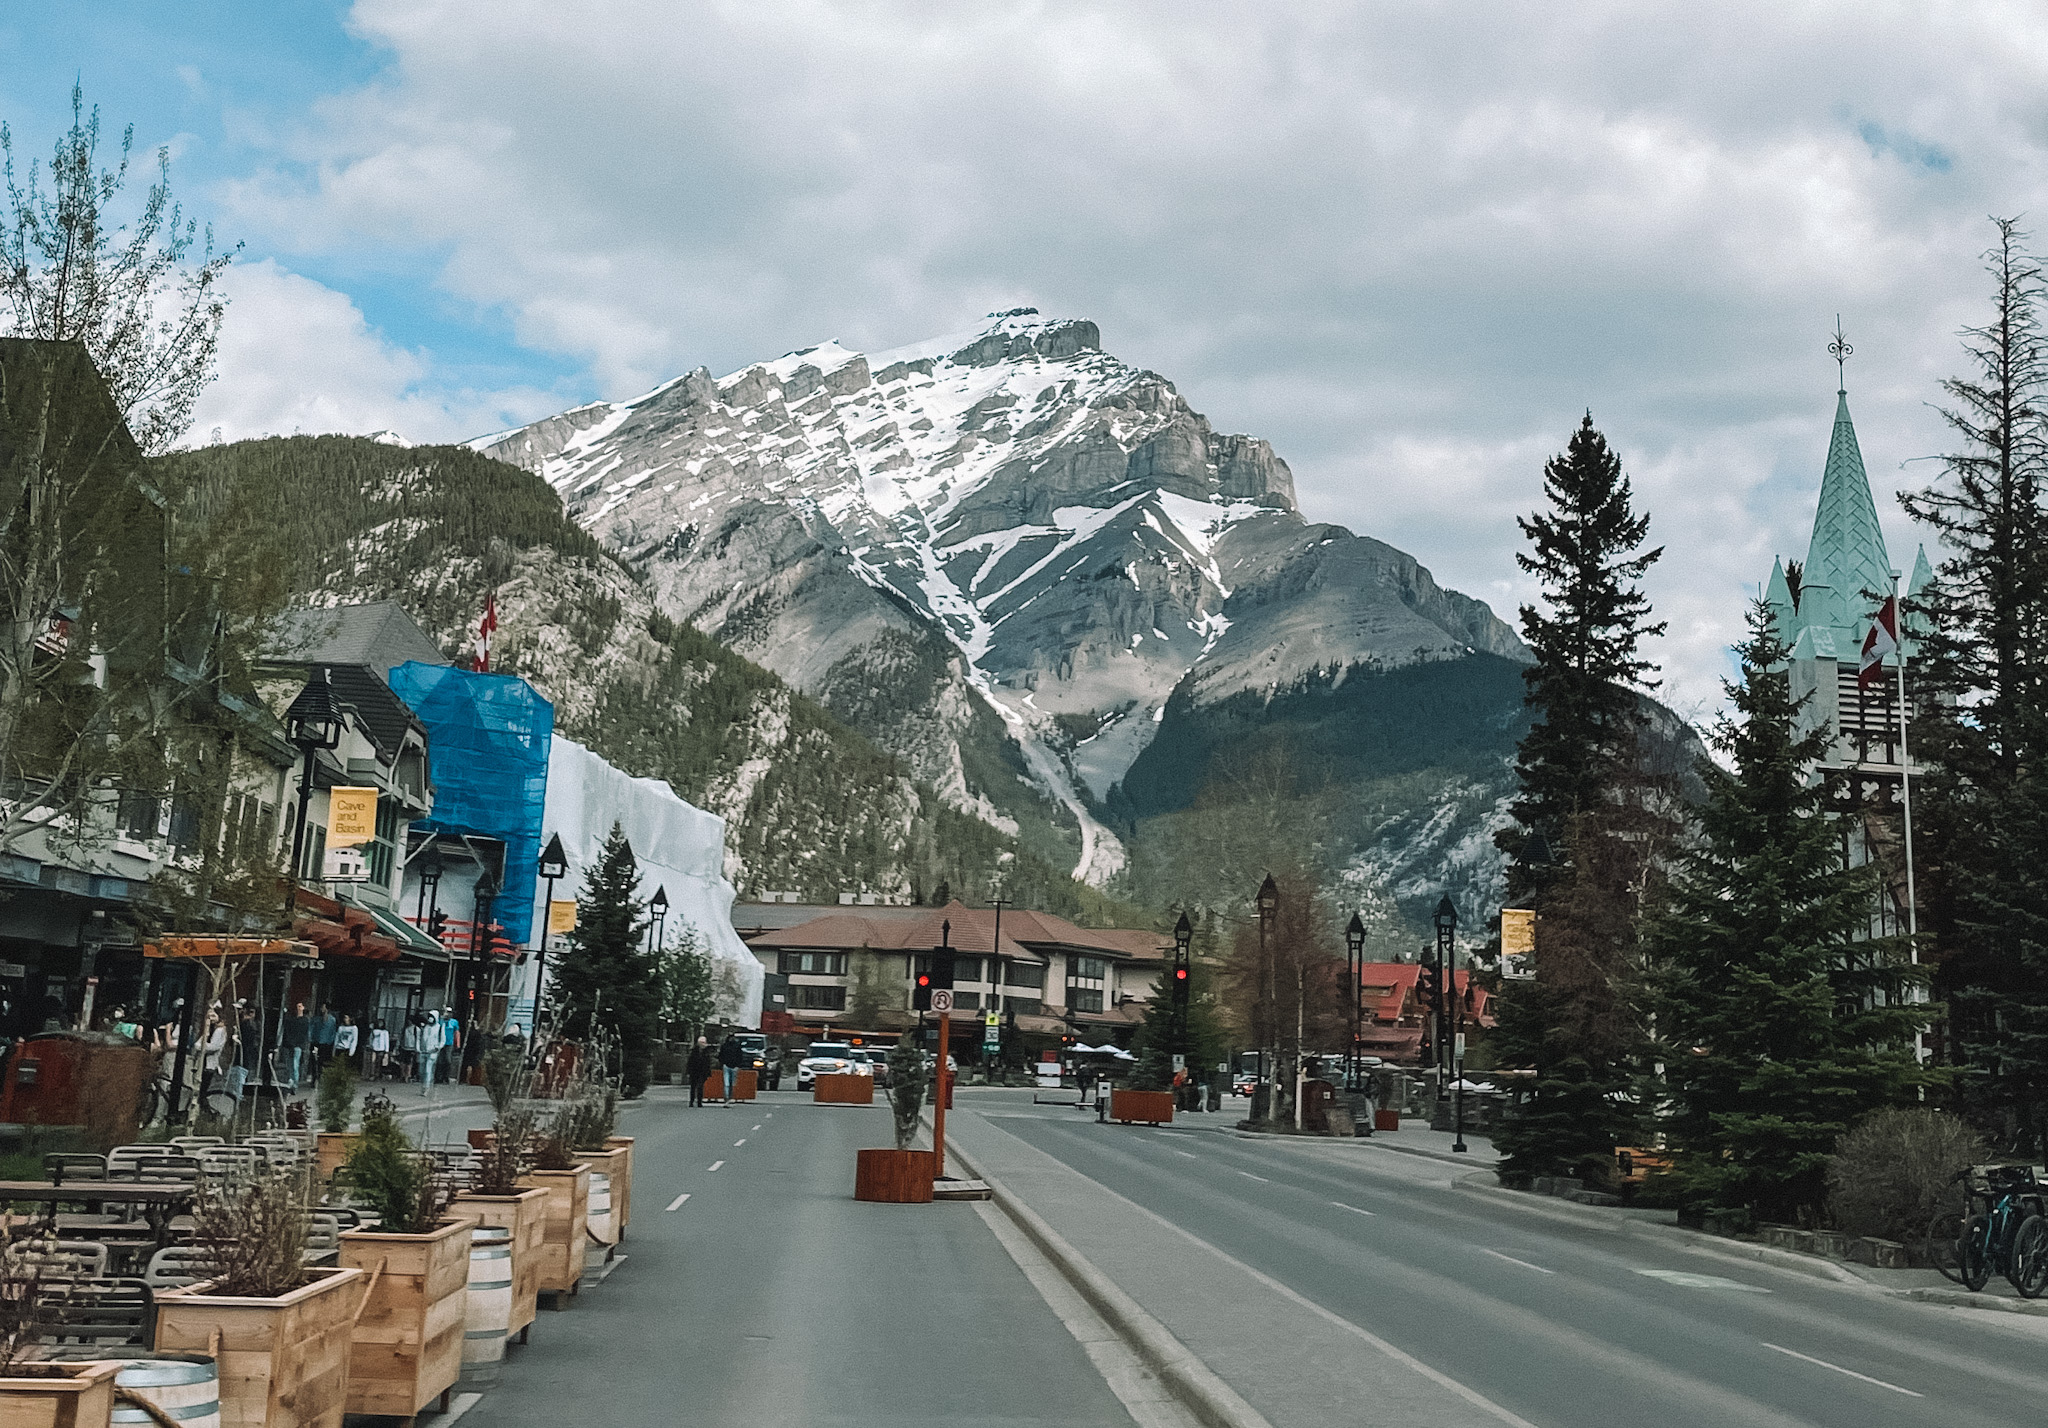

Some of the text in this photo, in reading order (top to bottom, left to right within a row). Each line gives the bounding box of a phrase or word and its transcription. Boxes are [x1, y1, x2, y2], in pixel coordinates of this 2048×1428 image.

[337, 800, 366, 811] Cave
[337, 812, 357, 821] and
[335, 823, 366, 833] Basin
